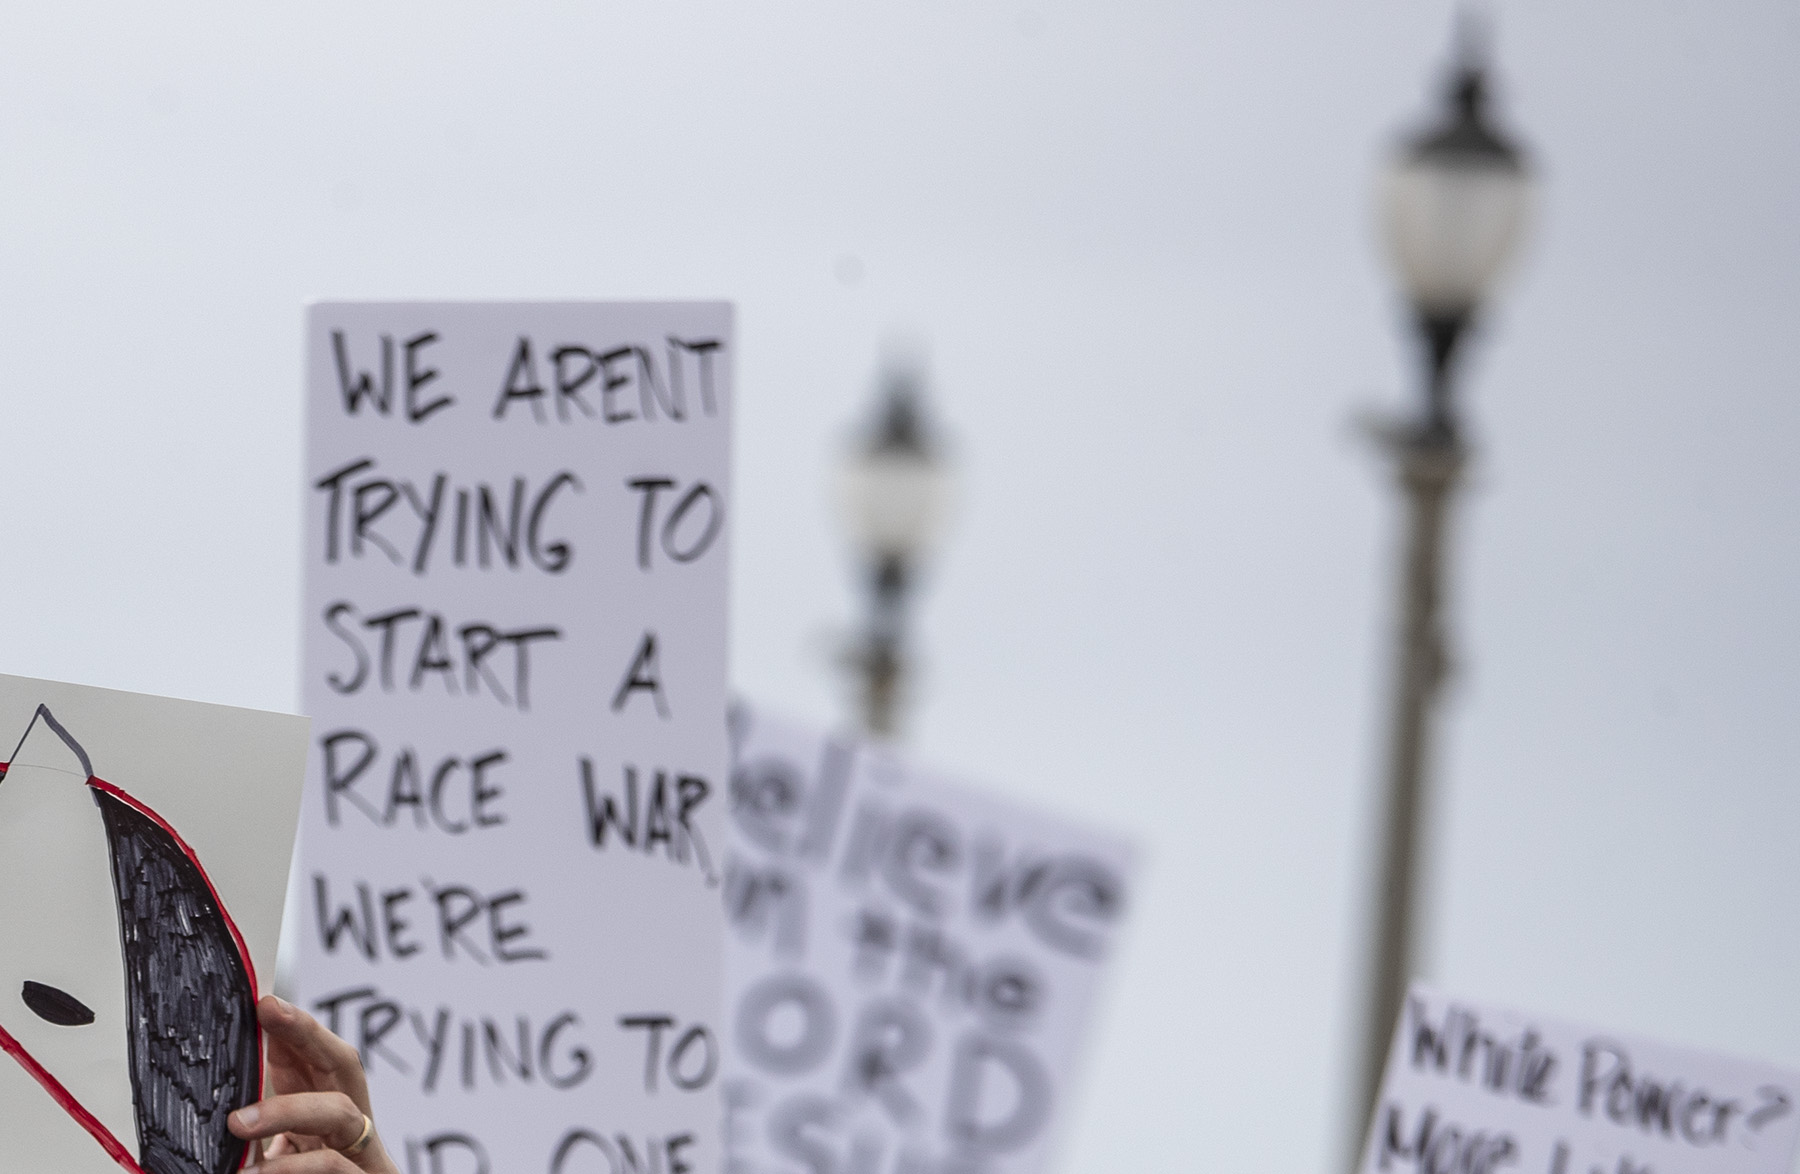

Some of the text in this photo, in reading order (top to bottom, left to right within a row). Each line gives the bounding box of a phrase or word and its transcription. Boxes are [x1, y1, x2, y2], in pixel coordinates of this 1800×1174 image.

[332, 330, 454, 423] WE
[315, 458, 724, 575] TRYING TO
[323, 602, 671, 719] START A
[320, 731, 509, 833] RACE
[726, 725, 1126, 965] elieve
[618, 1016, 718, 1094] TO
[735, 972, 1055, 1157] ORD
